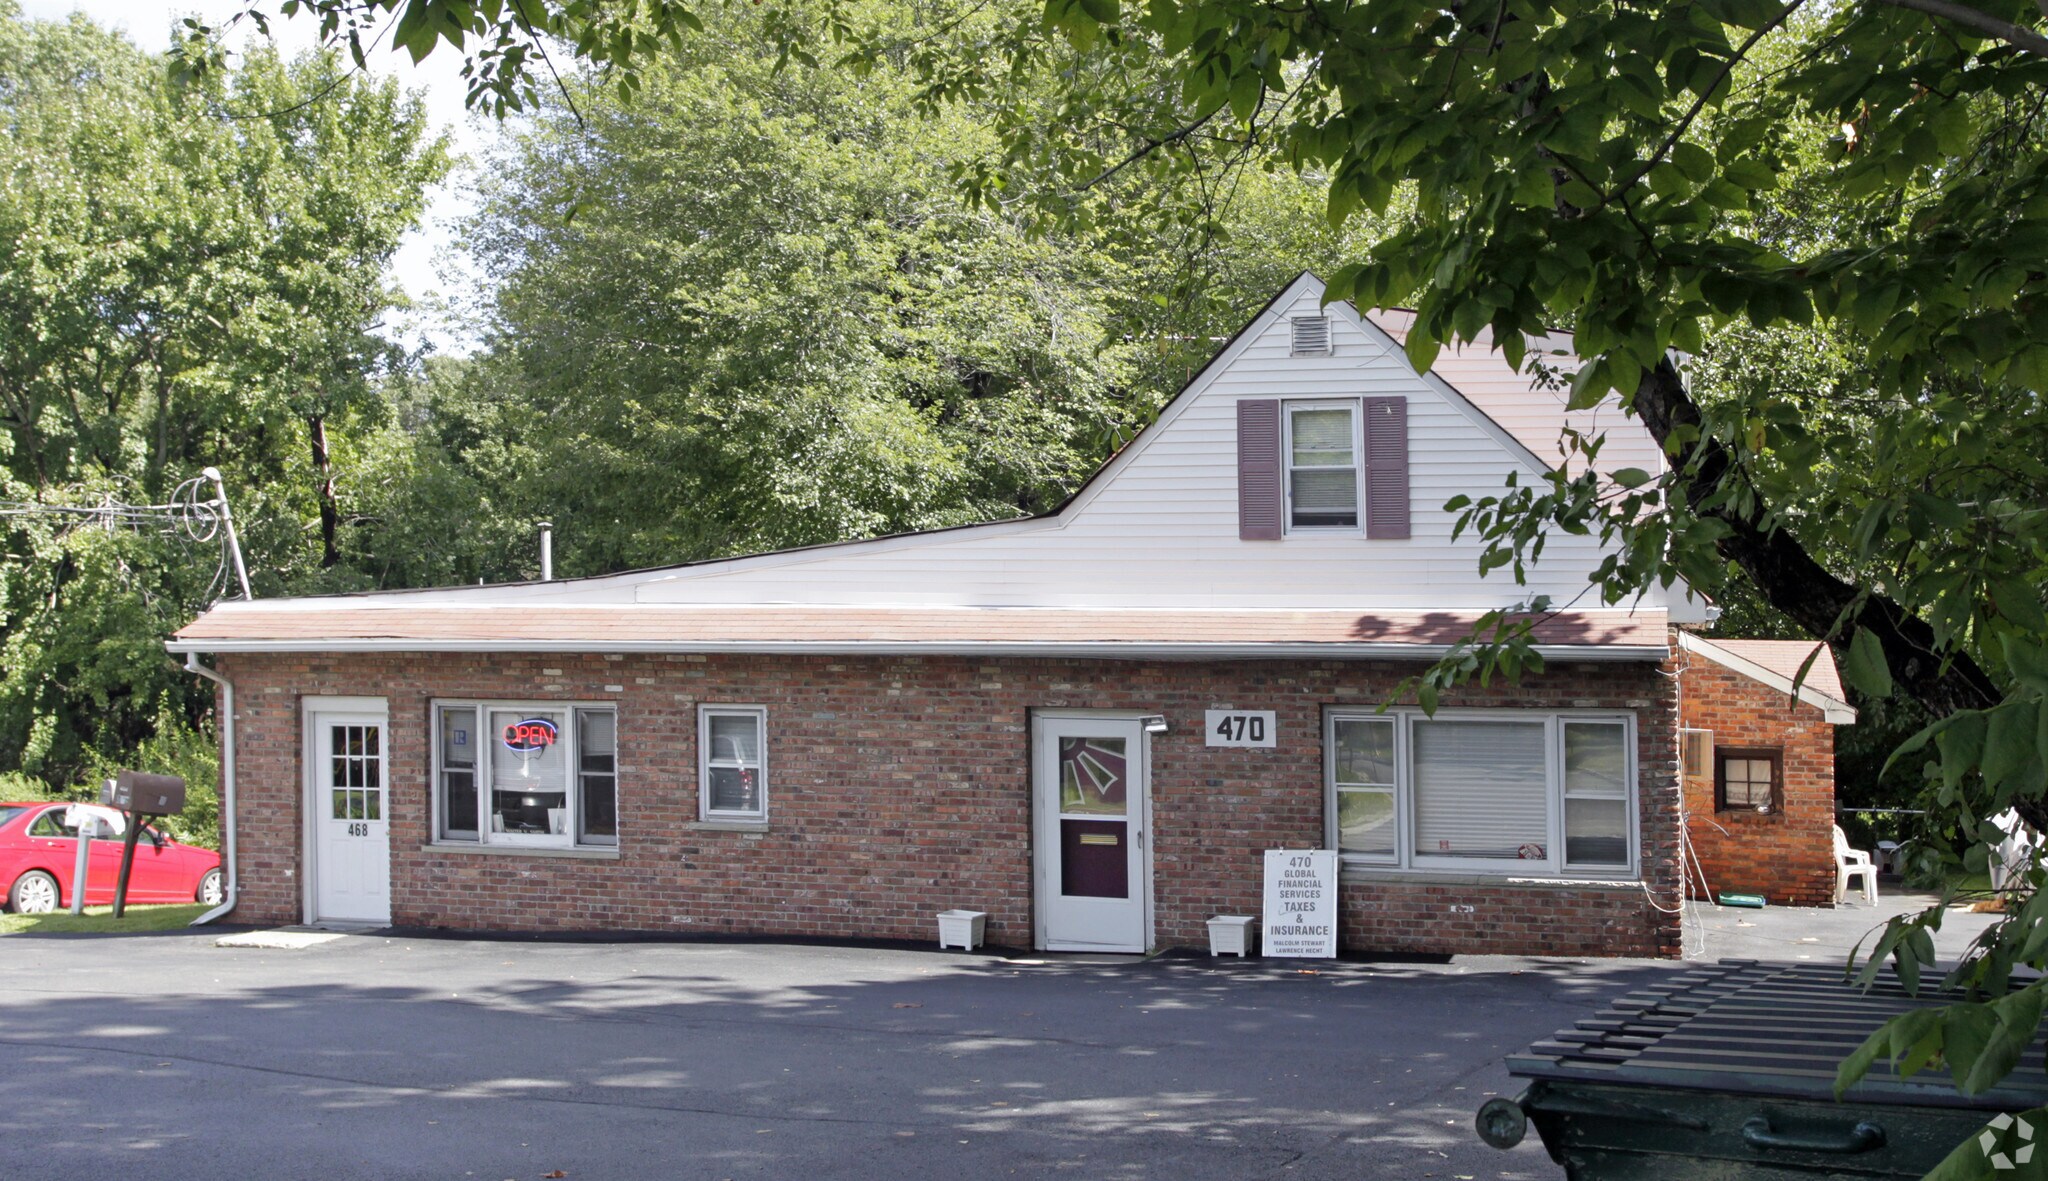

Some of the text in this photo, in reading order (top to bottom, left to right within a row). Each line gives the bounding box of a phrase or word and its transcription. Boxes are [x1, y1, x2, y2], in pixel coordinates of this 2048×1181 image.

[1217, 716, 1264, 741] 470
[503, 724, 553, 745] OPEN
[348, 823, 368, 837] 468
[1290, 857, 1311, 867] 470
[1284, 870, 1316, 878] GLOBAL
[1278, 880, 1322, 888] FINANCIAL
[1280, 890, 1320, 898] SERVICES
[1285, 902, 1315, 911] TAXES
[1296, 913, 1303, 924] &
[1271, 926, 1328, 935] INSURANCE
